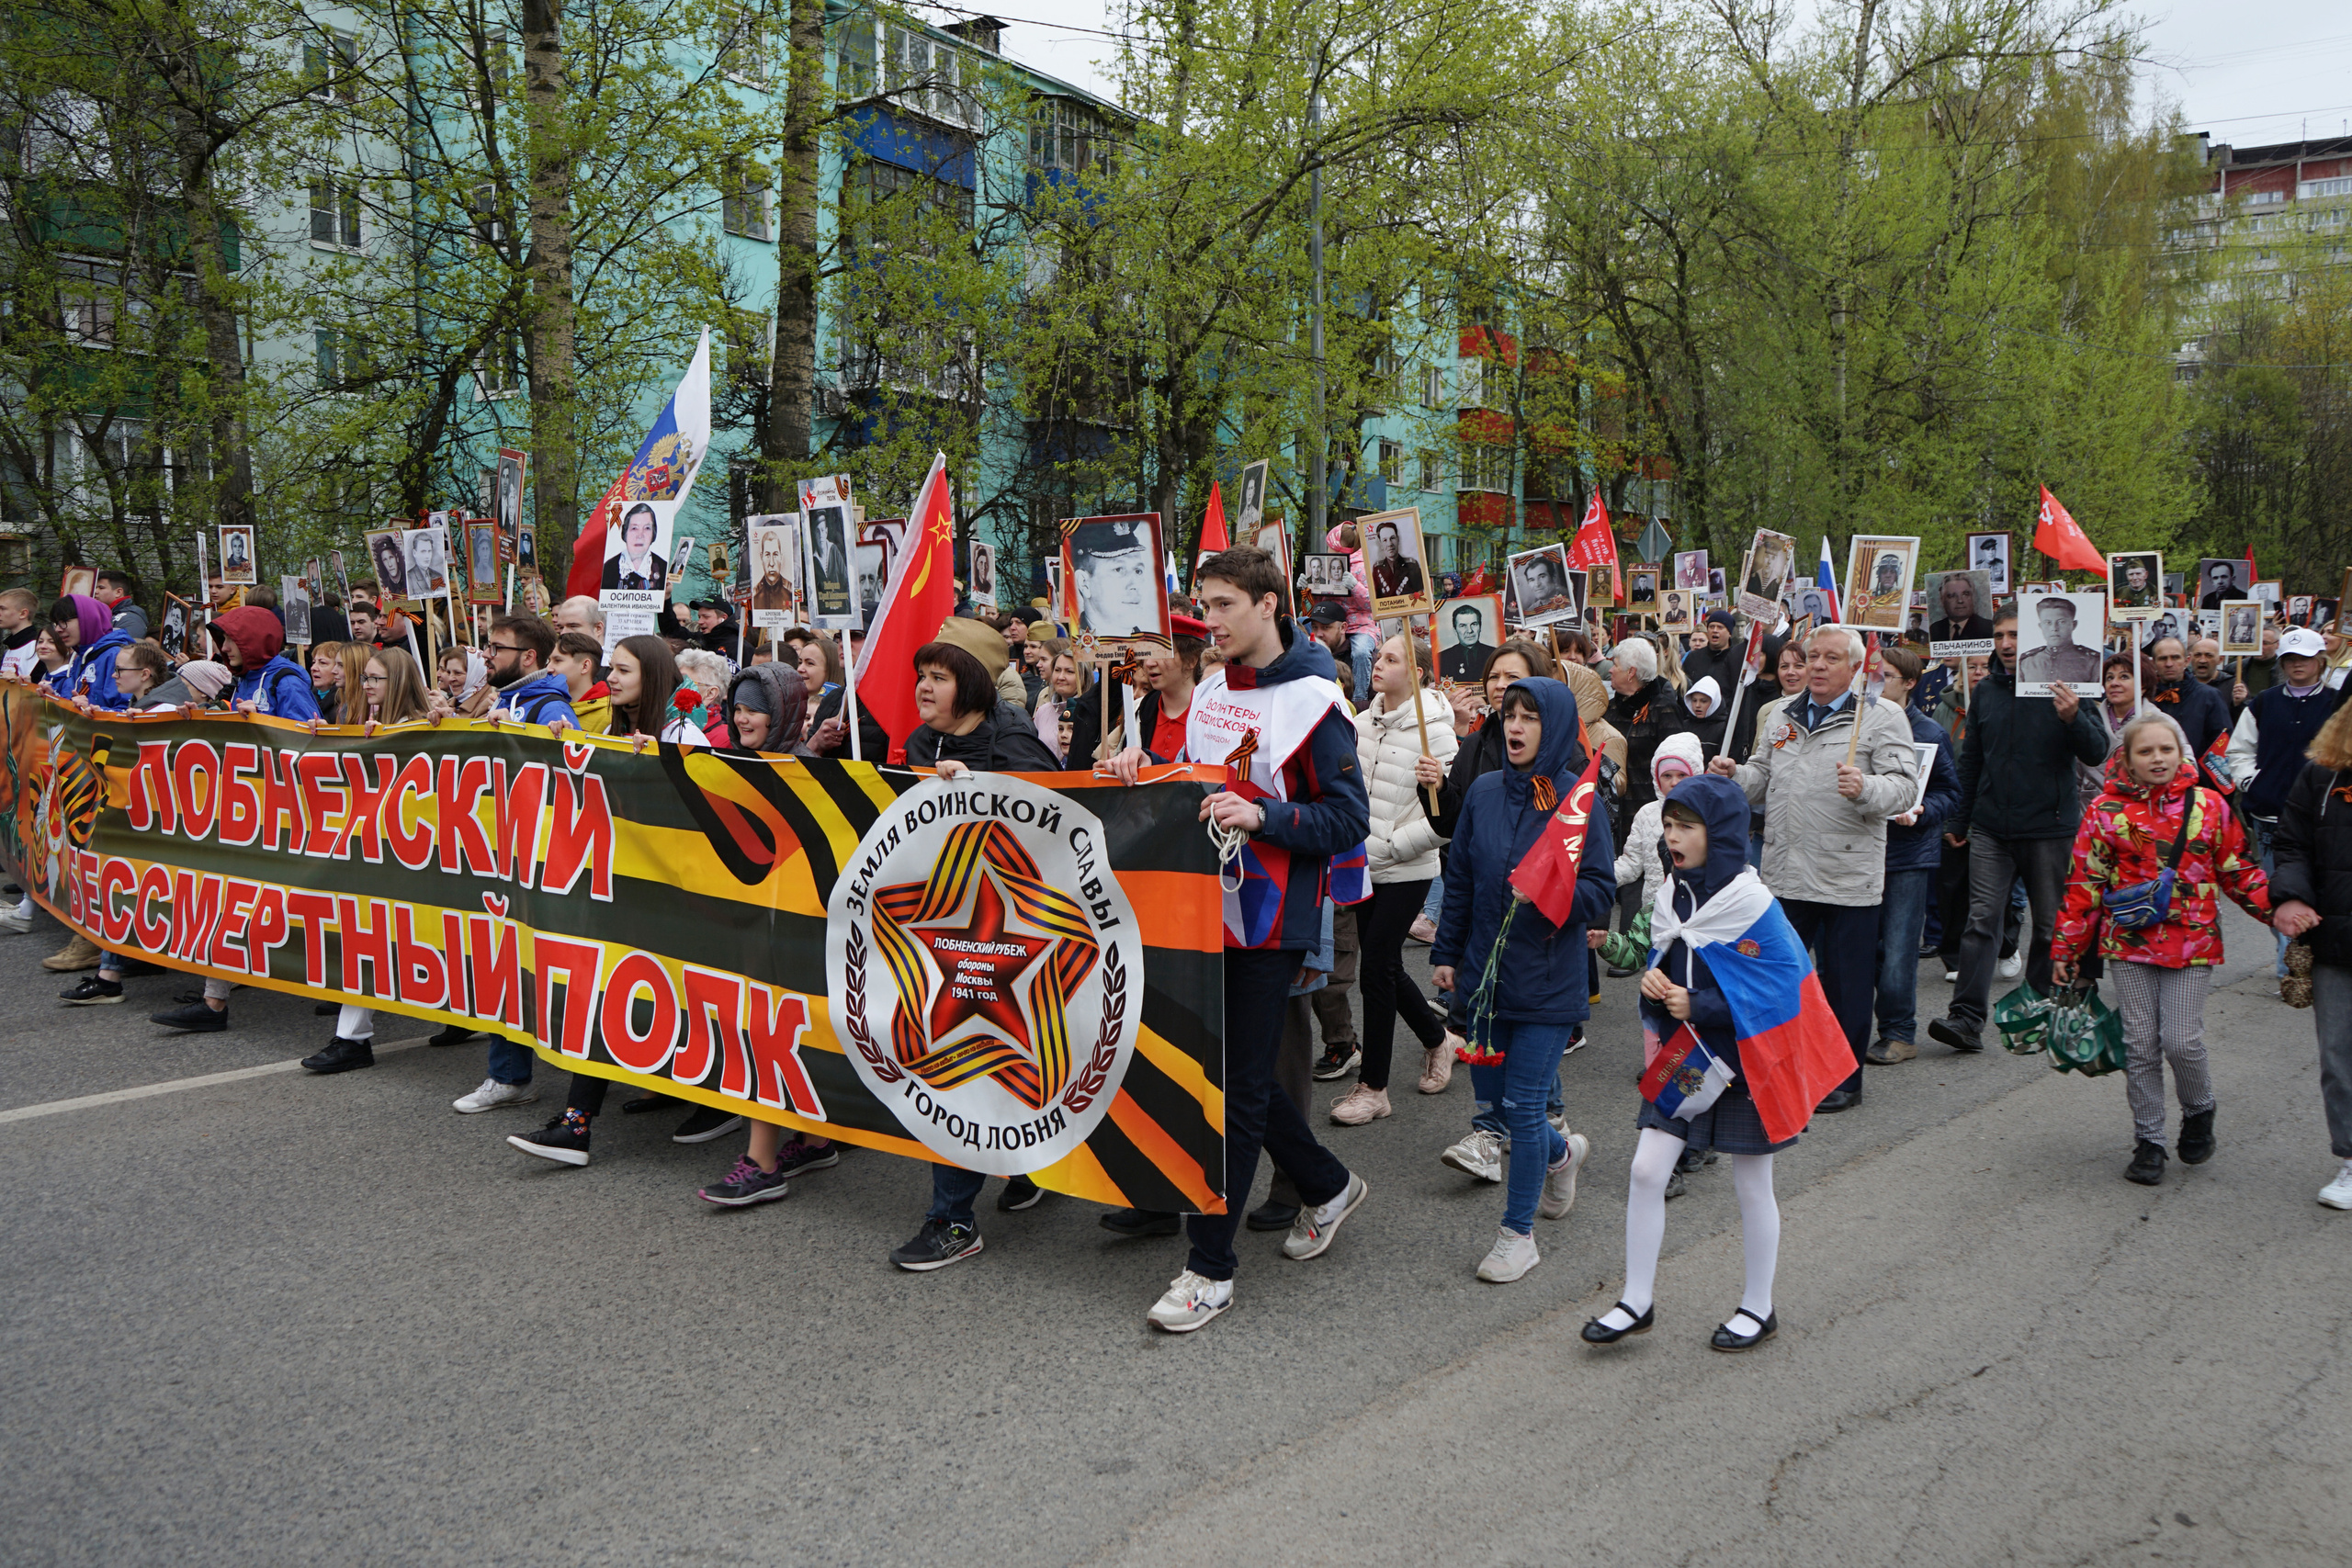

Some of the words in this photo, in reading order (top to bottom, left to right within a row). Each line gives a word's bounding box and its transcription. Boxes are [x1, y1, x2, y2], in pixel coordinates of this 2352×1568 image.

[610, 592, 652, 602] ОСИПОВА
[1933, 640, 1992, 650] ЕЛЬЧАНИНОВ
[1205, 698, 1261, 721] ВОЛНТЕРЫ
[126, 739, 614, 903] ЛОБНЕНСКИЙ
[846, 823, 901, 916] ЗЕМЛЯ
[904, 790, 1062, 834] ВОИНСКОЙ
[1069, 827, 1121, 931] СЛАВЫ
[933, 937, 995, 954] ЛОБНЕНСКИЙ
[993, 943, 1027, 957] РУБЕЖ
[957, 958, 994, 972] обороны
[69, 845, 524, 1031] БЕССМЕРТНЫЙ
[534, 931, 827, 1122] ПОЛК
[955, 972, 993, 986] Москвы
[952, 987, 974, 999] 1941
[977, 991, 999, 1001] год
[904, 1081, 980, 1152] ГОРОД
[986, 1105, 1068, 1151] ЛОБНЯ
